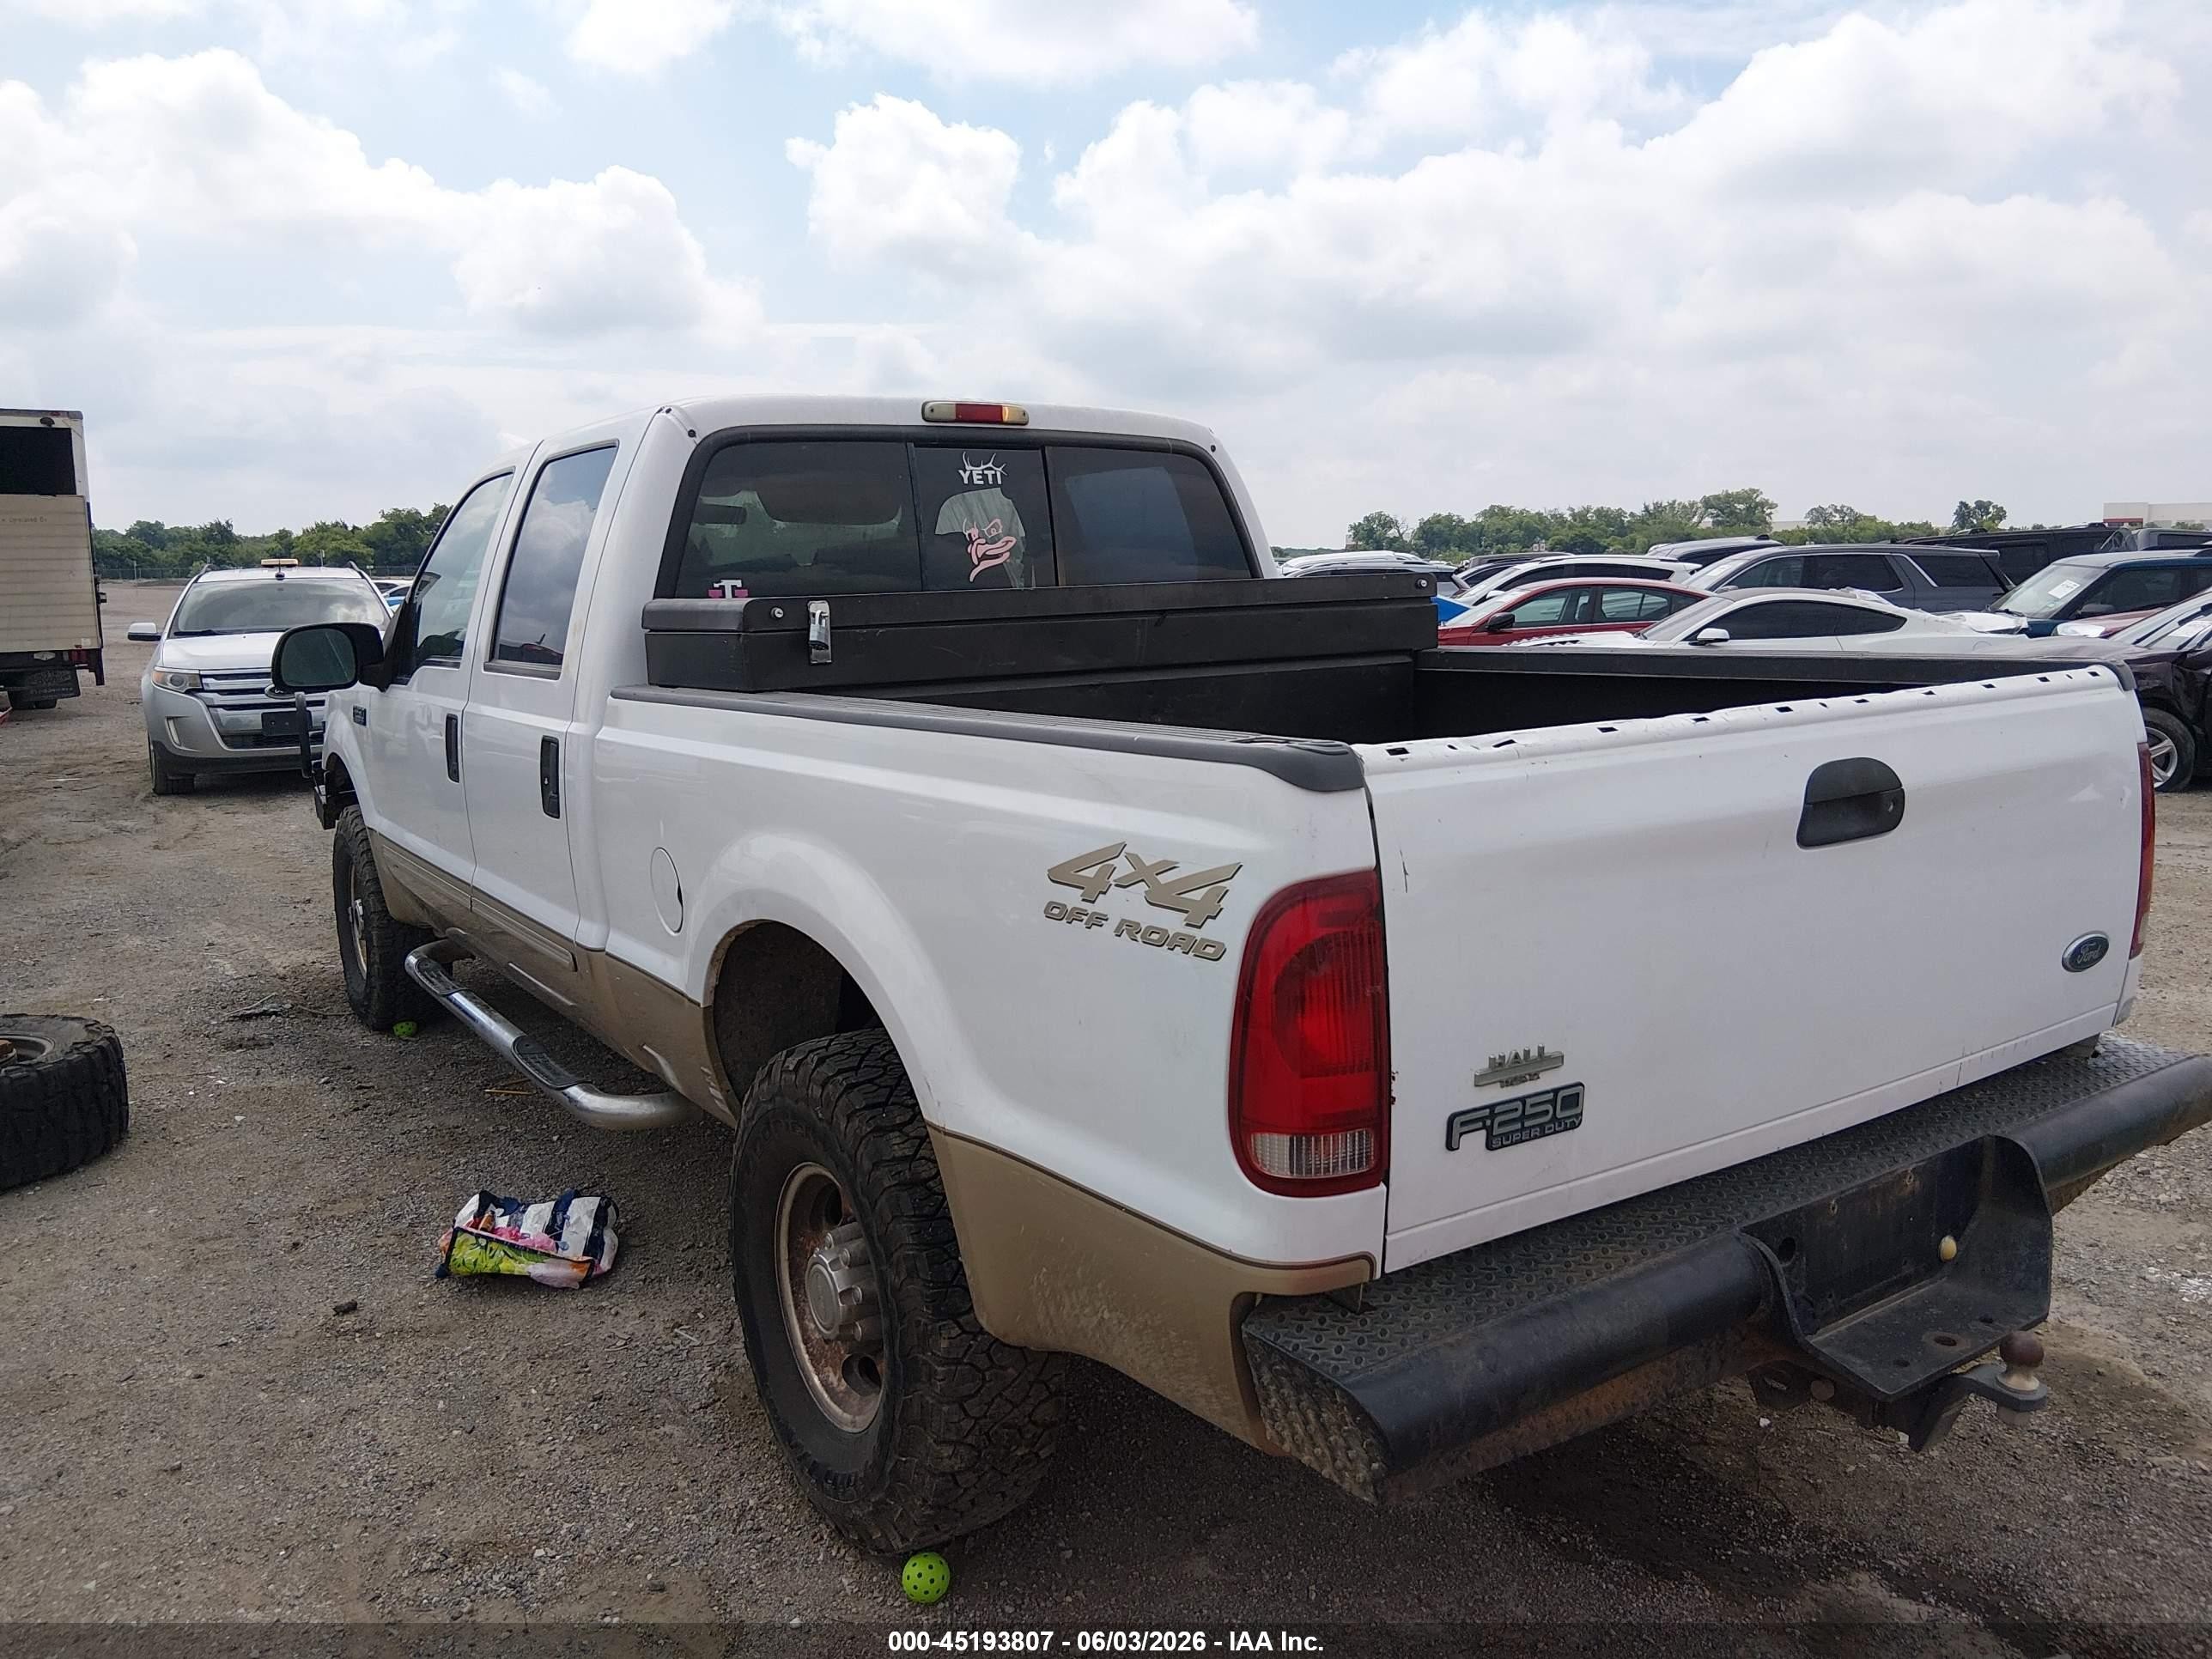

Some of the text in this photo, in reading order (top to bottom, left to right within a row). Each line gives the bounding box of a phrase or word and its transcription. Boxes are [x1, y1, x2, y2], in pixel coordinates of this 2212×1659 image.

[957, 469, 1004, 485] YETI
[1043, 900, 1227, 962] OFF ROAD
[1492, 1117, 1582, 1148] SUPER DUTY
